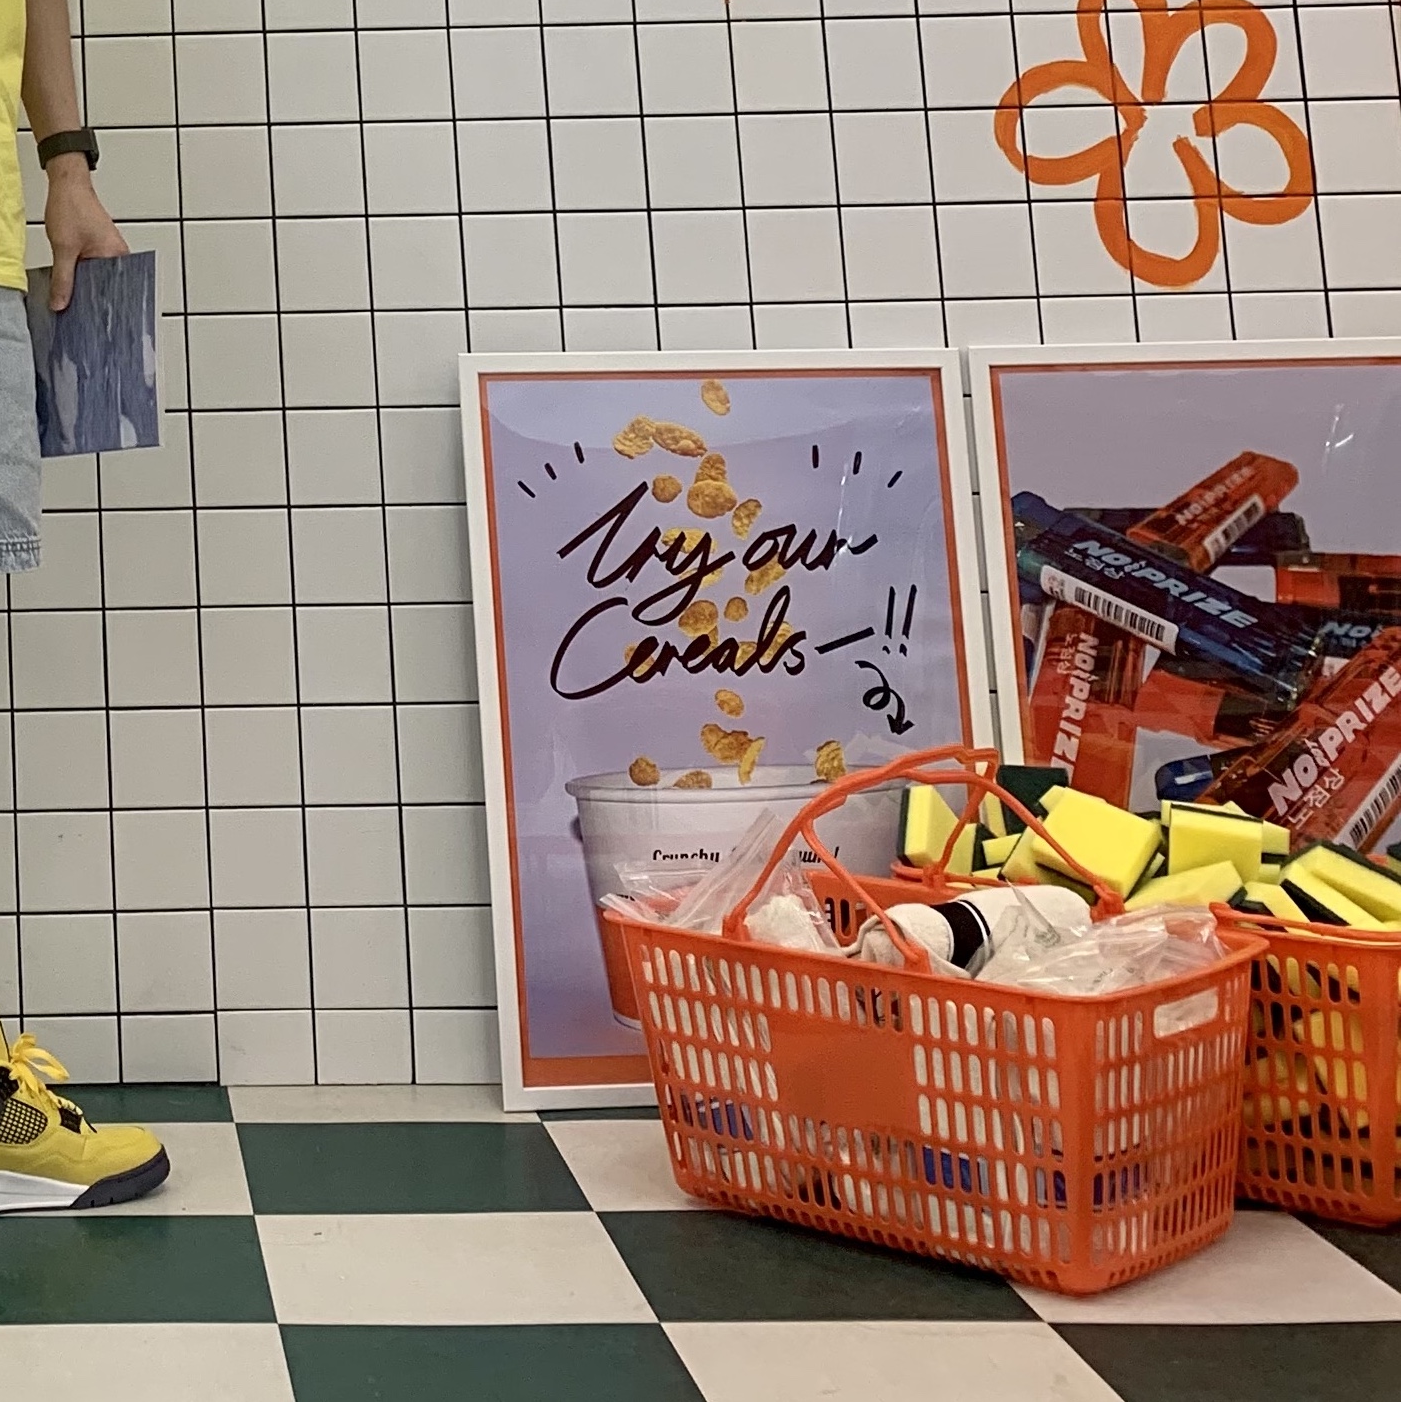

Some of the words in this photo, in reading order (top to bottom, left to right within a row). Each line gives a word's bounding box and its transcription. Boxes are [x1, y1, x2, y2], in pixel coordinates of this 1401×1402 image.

[558, 481, 736, 626] Try
[1132, 567, 1258, 629] PRIZE
[1268, 753, 1319, 817] NO
[1318, 665, 1401, 762] PRIZE
